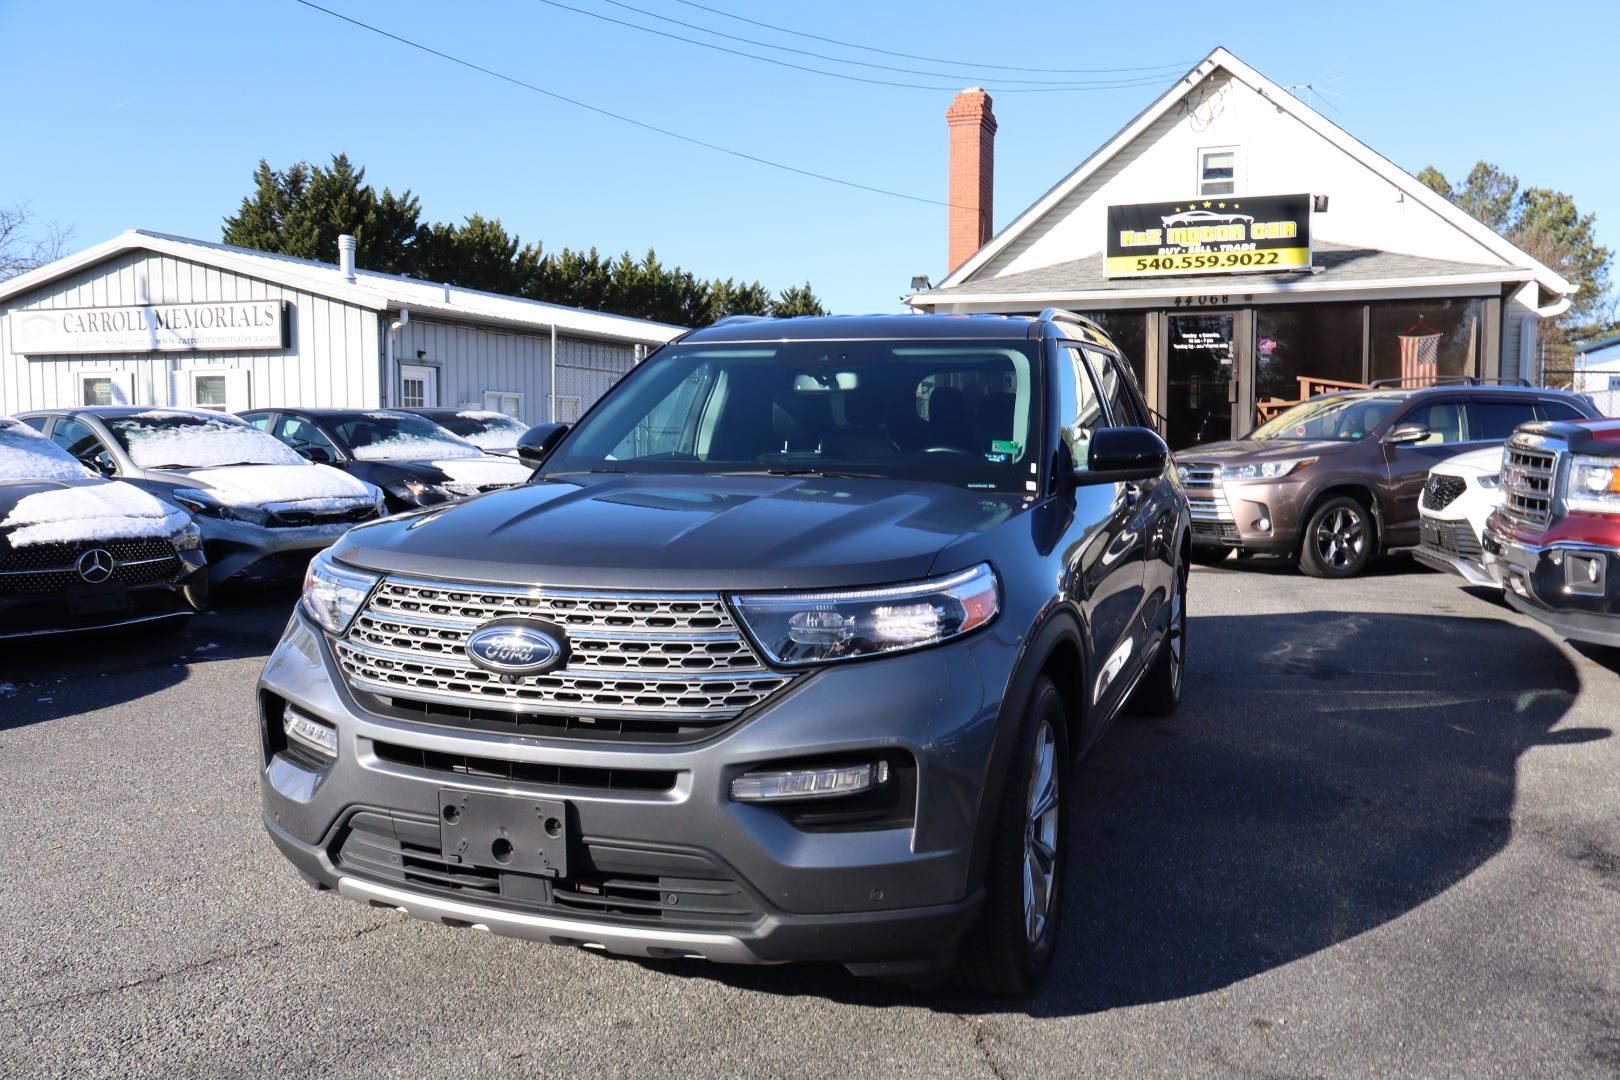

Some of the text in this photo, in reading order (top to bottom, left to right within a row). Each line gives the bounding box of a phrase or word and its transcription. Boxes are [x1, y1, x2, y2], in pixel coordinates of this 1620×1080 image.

[1158, 243, 1256, 255] BUY SELL TRADE
[1136, 252, 1279, 271] 540.559.9022
[63, 305, 274, 333] CARROLL MEMORIALS
[76, 338, 102, 347] Indoor
[105, 337, 146, 347] Showroom
[485, 636, 533, 661] Ford
